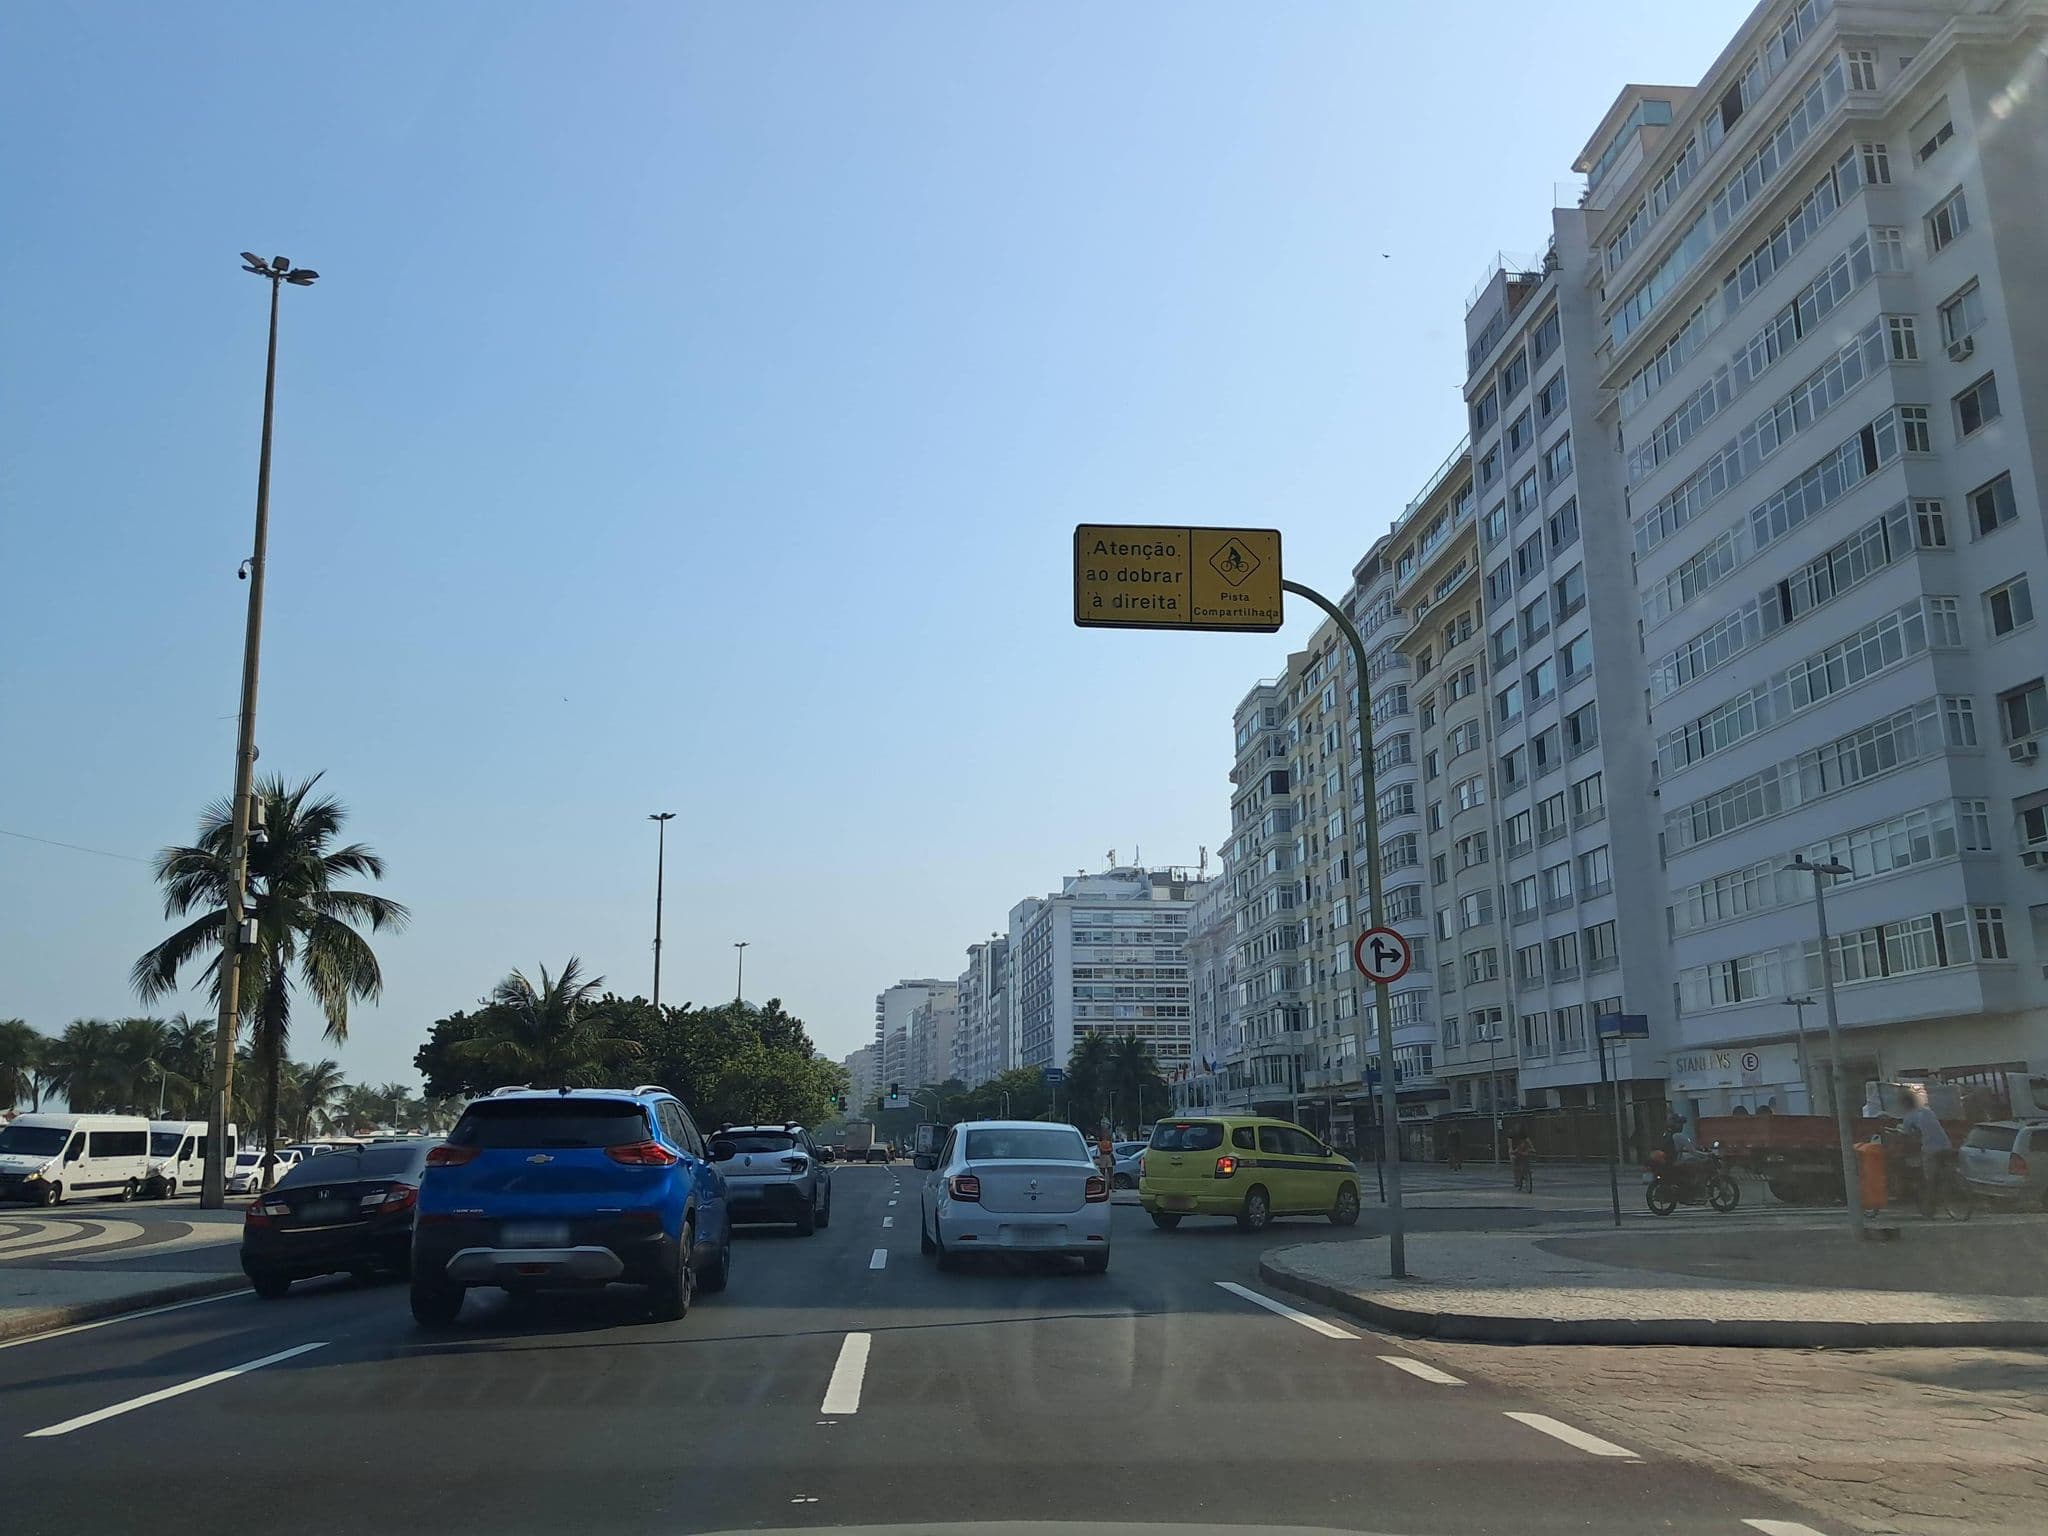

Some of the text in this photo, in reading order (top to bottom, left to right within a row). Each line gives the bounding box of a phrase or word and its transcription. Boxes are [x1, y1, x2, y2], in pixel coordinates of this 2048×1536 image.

[1093, 541, 1176, 560] Atenção
[1086, 568, 1183, 584] ao dobrar
[1092, 592, 1177, 610] à direita
[1221, 592, 1250, 602] Pista
[1193, 607, 1279, 619] Compartilhada
